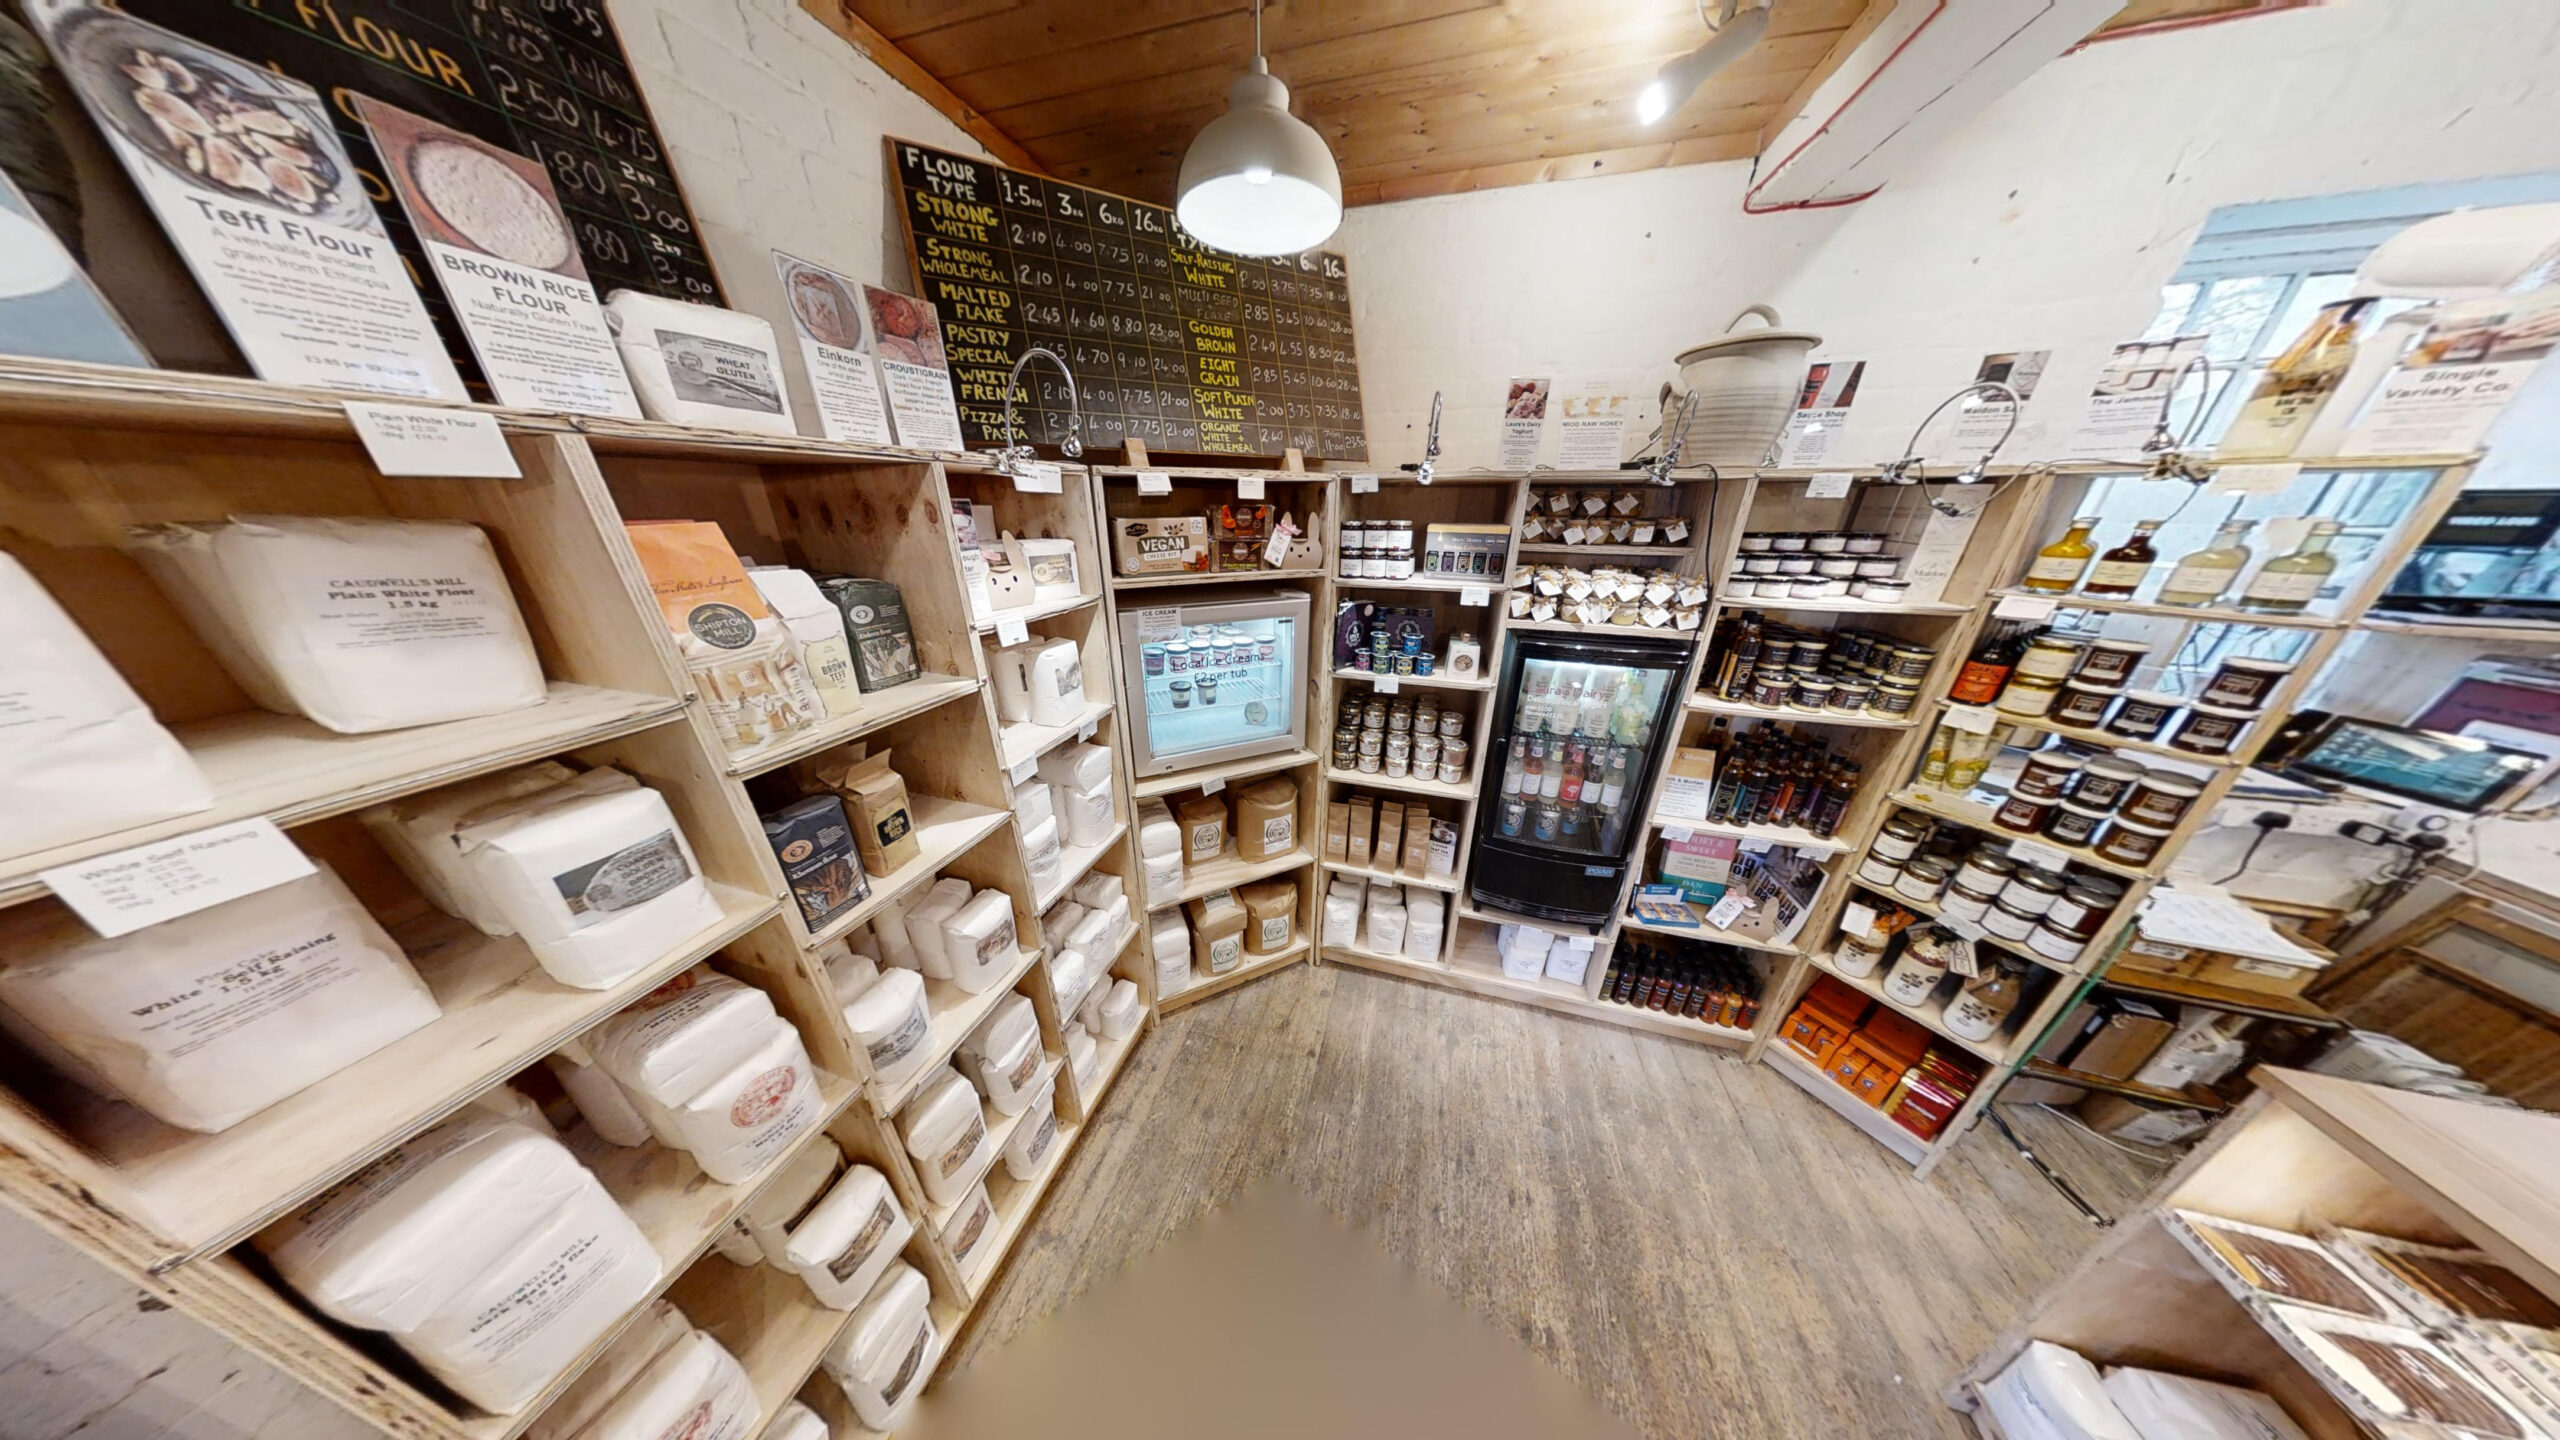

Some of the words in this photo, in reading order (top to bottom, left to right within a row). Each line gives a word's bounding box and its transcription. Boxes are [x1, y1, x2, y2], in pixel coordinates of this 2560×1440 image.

[489, 64, 580, 128] 2.50
[594, 109, 659, 164] 4.75
[905, 146, 977, 184] FLOUR
[926, 175, 977, 201] TYPE
[916, 191, 999, 227] STRONG
[185, 195, 270, 235] Teff
[280, 220, 375, 260] Flour
[930, 216, 989, 242] WHITE
[1011, 223, 1047, 245] 2.10
[926, 237, 993, 267] STRONG
[441, 253, 537, 289] BROWN
[541, 279, 593, 304] RICE
[920, 257, 1010, 284] WHOLEMEAL
[1183, 265, 1227, 288] WHITE
[491, 286, 571, 316] FLOUR
[938, 282, 1011, 308] MALTED
[955, 302, 1008, 324] FLAKE
[946, 324, 1010, 347] PASTRY
[1188, 320, 1234, 339] GOLDEN
[1196, 337, 1237, 354] BROWN
[1249, 334, 1276, 351] 2.40
[715, 356, 751, 370] WHEAT
[817, 346, 861, 367] Einkorn
[946, 343, 1015, 365] SPECIAL
[1076, 346, 1109, 365] 4.70
[1117, 352, 1146, 368] 9.10
[1200, 357, 1237, 373] EIGHT
[715, 367, 755, 380] GLUTEN
[883, 362, 948, 381] CROUSTIGRAIN
[1200, 372, 1240, 387] GRAIN
[1253, 366, 1278, 383] 2.85
[2420, 366, 2500, 384] Single
[1082, 385, 1115, 402] 4.00
[1160, 391, 1190, 407] 21.00
[1193, 388, 1221, 405] SOFT
[1224, 391, 1255, 407] PLAIN
[2092, 398, 2113, 406] The
[2384, 384, 2466, 401] Variety
[959, 405, 1006, 425] PIZZA
[1010, 407, 1026, 425] &
[1202, 404, 1245, 420] WHITE
[1963, 406, 2000, 415] Maldon
[406, 416, 443, 425] White
[446, 418, 478, 428] Flour
[982, 425, 1028, 441] PASTA
[1089, 415, 1123, 431] 4.00
[1201, 422, 1243, 433] ORGANIC
[1201, 432, 1232, 442] WHITE
[1202, 441, 1256, 453] WHOLEMEAL
[1141, 537, 1185, 551] VEGAN
[329, 578, 431, 589] CAUDWELL'S
[434, 578, 466, 586] MILL
[328, 590, 377, 600] Plain
[381, 589, 431, 598] White
[435, 589, 475, 597] Flour
[418, 601, 439, 609] kg
[694, 616, 747, 632] SHIPTON
[713, 627, 741, 637] MILL
[821, 661, 847, 675] BROWN
[1172, 658, 1204, 671] Local
[1205, 657, 1222, 667] Ice
[1224, 652, 1265, 665] Creams
[829, 671, 847, 682] TEFF
[1194, 672, 1207, 683] £2
[1209, 671, 1227, 683] per
[1231, 668, 1248, 678] tub
[1573, 688, 1608, 701] Dairy
[79, 861, 142, 880] White
[146, 848, 184, 863] Self
[189, 830, 259, 851] Raising
[1587, 868, 1613, 876] POLAR
[1682, 880, 1703, 889] DAN
[1761, 875, 1799, 918] baking
[130, 988, 203, 1016] White
[222, 962, 263, 983] Self
[266, 932, 336, 965] Raising
[259, 965, 285, 978] kg
[470, 1307, 510, 1333] Dark
[516, 1264, 565, 1304] Malted
